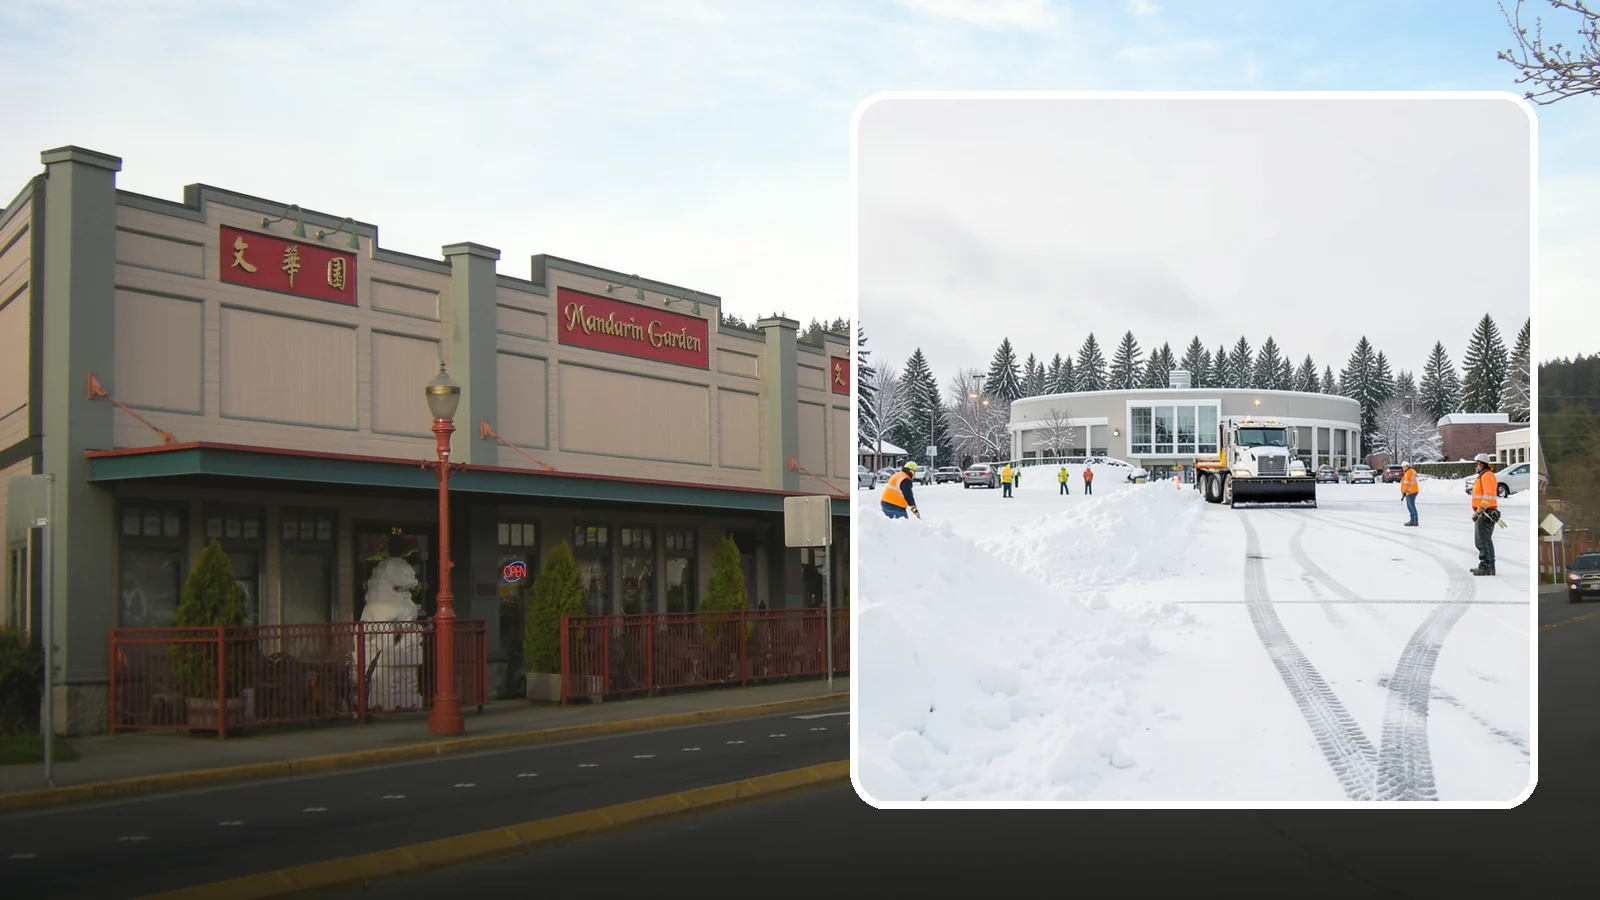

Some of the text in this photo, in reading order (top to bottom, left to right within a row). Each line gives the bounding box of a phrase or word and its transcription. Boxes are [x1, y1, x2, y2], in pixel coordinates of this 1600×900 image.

[565, 302, 701, 353] Mandarin Garden
[503, 566, 527, 578] OPEN
